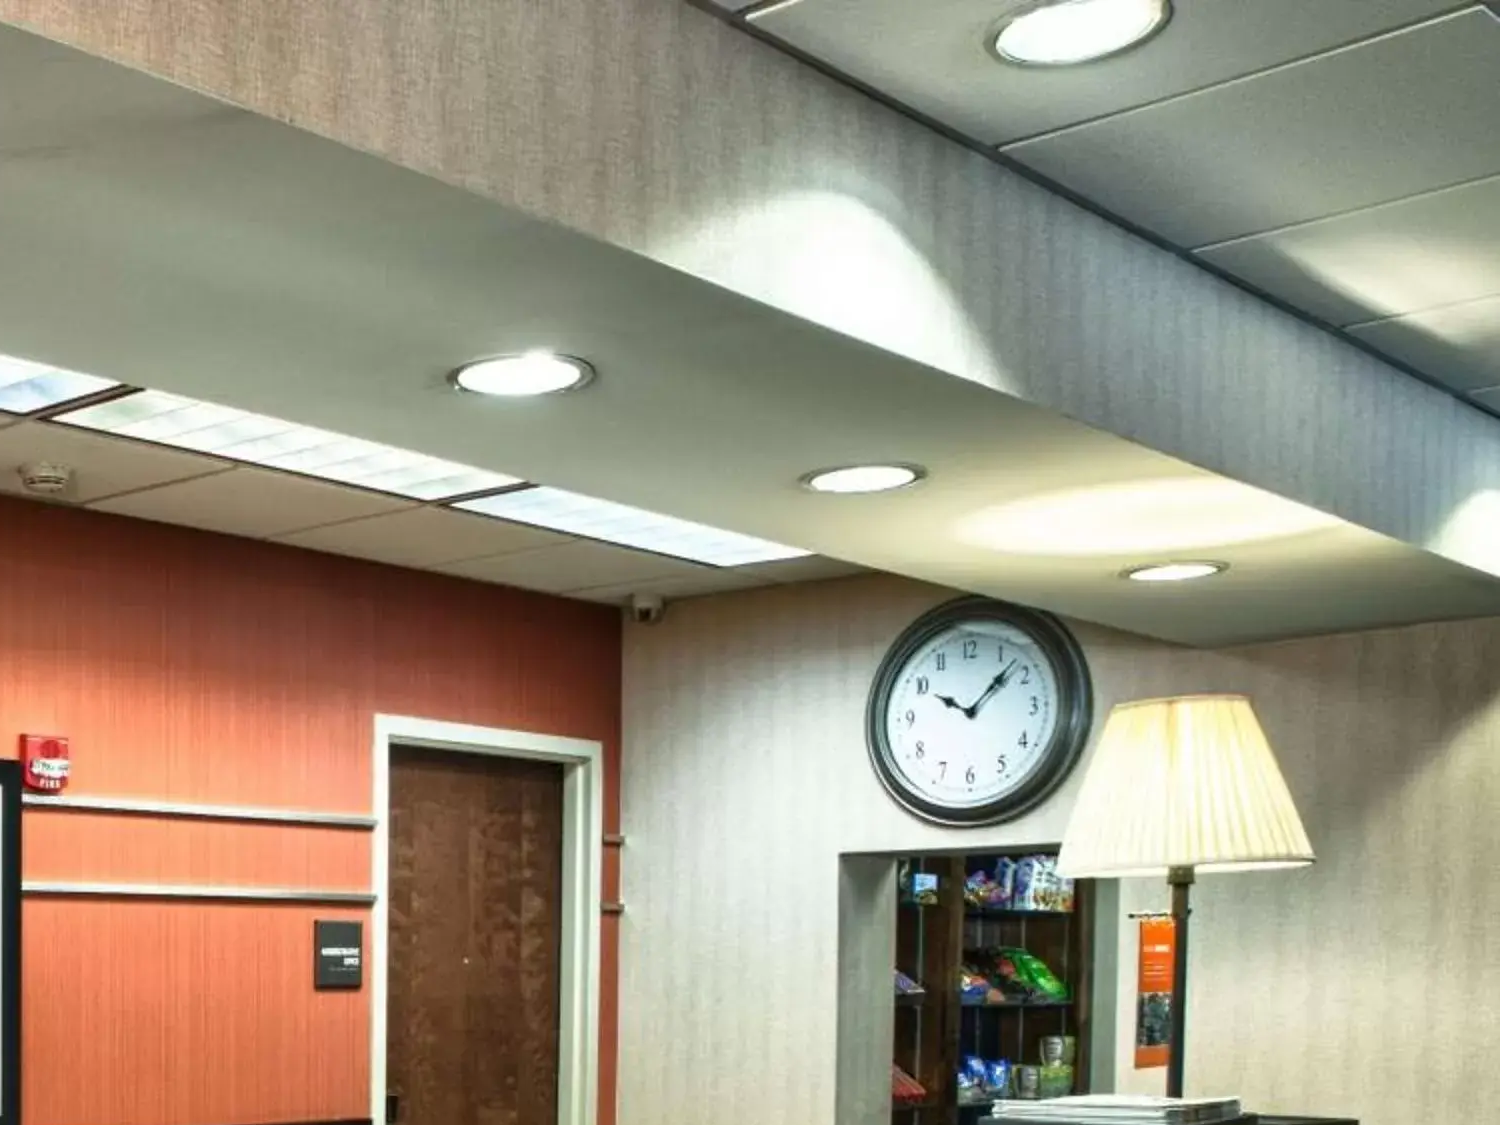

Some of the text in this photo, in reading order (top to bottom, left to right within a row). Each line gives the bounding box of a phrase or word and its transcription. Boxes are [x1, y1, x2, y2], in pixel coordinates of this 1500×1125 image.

[963, 640, 977, 659] 12
[936, 652, 946, 671] 11
[1020, 665, 1029, 684] 2
[916, 676, 929, 694] 10
[1029, 696, 1039, 715] 3
[906, 711, 915, 729] 9
[1018, 730, 1028, 748] 4
[915, 740, 924, 759] 8
[939, 761, 948, 779] 7
[997, 755, 1006, 774] 5
[965, 766, 975, 784] 6
